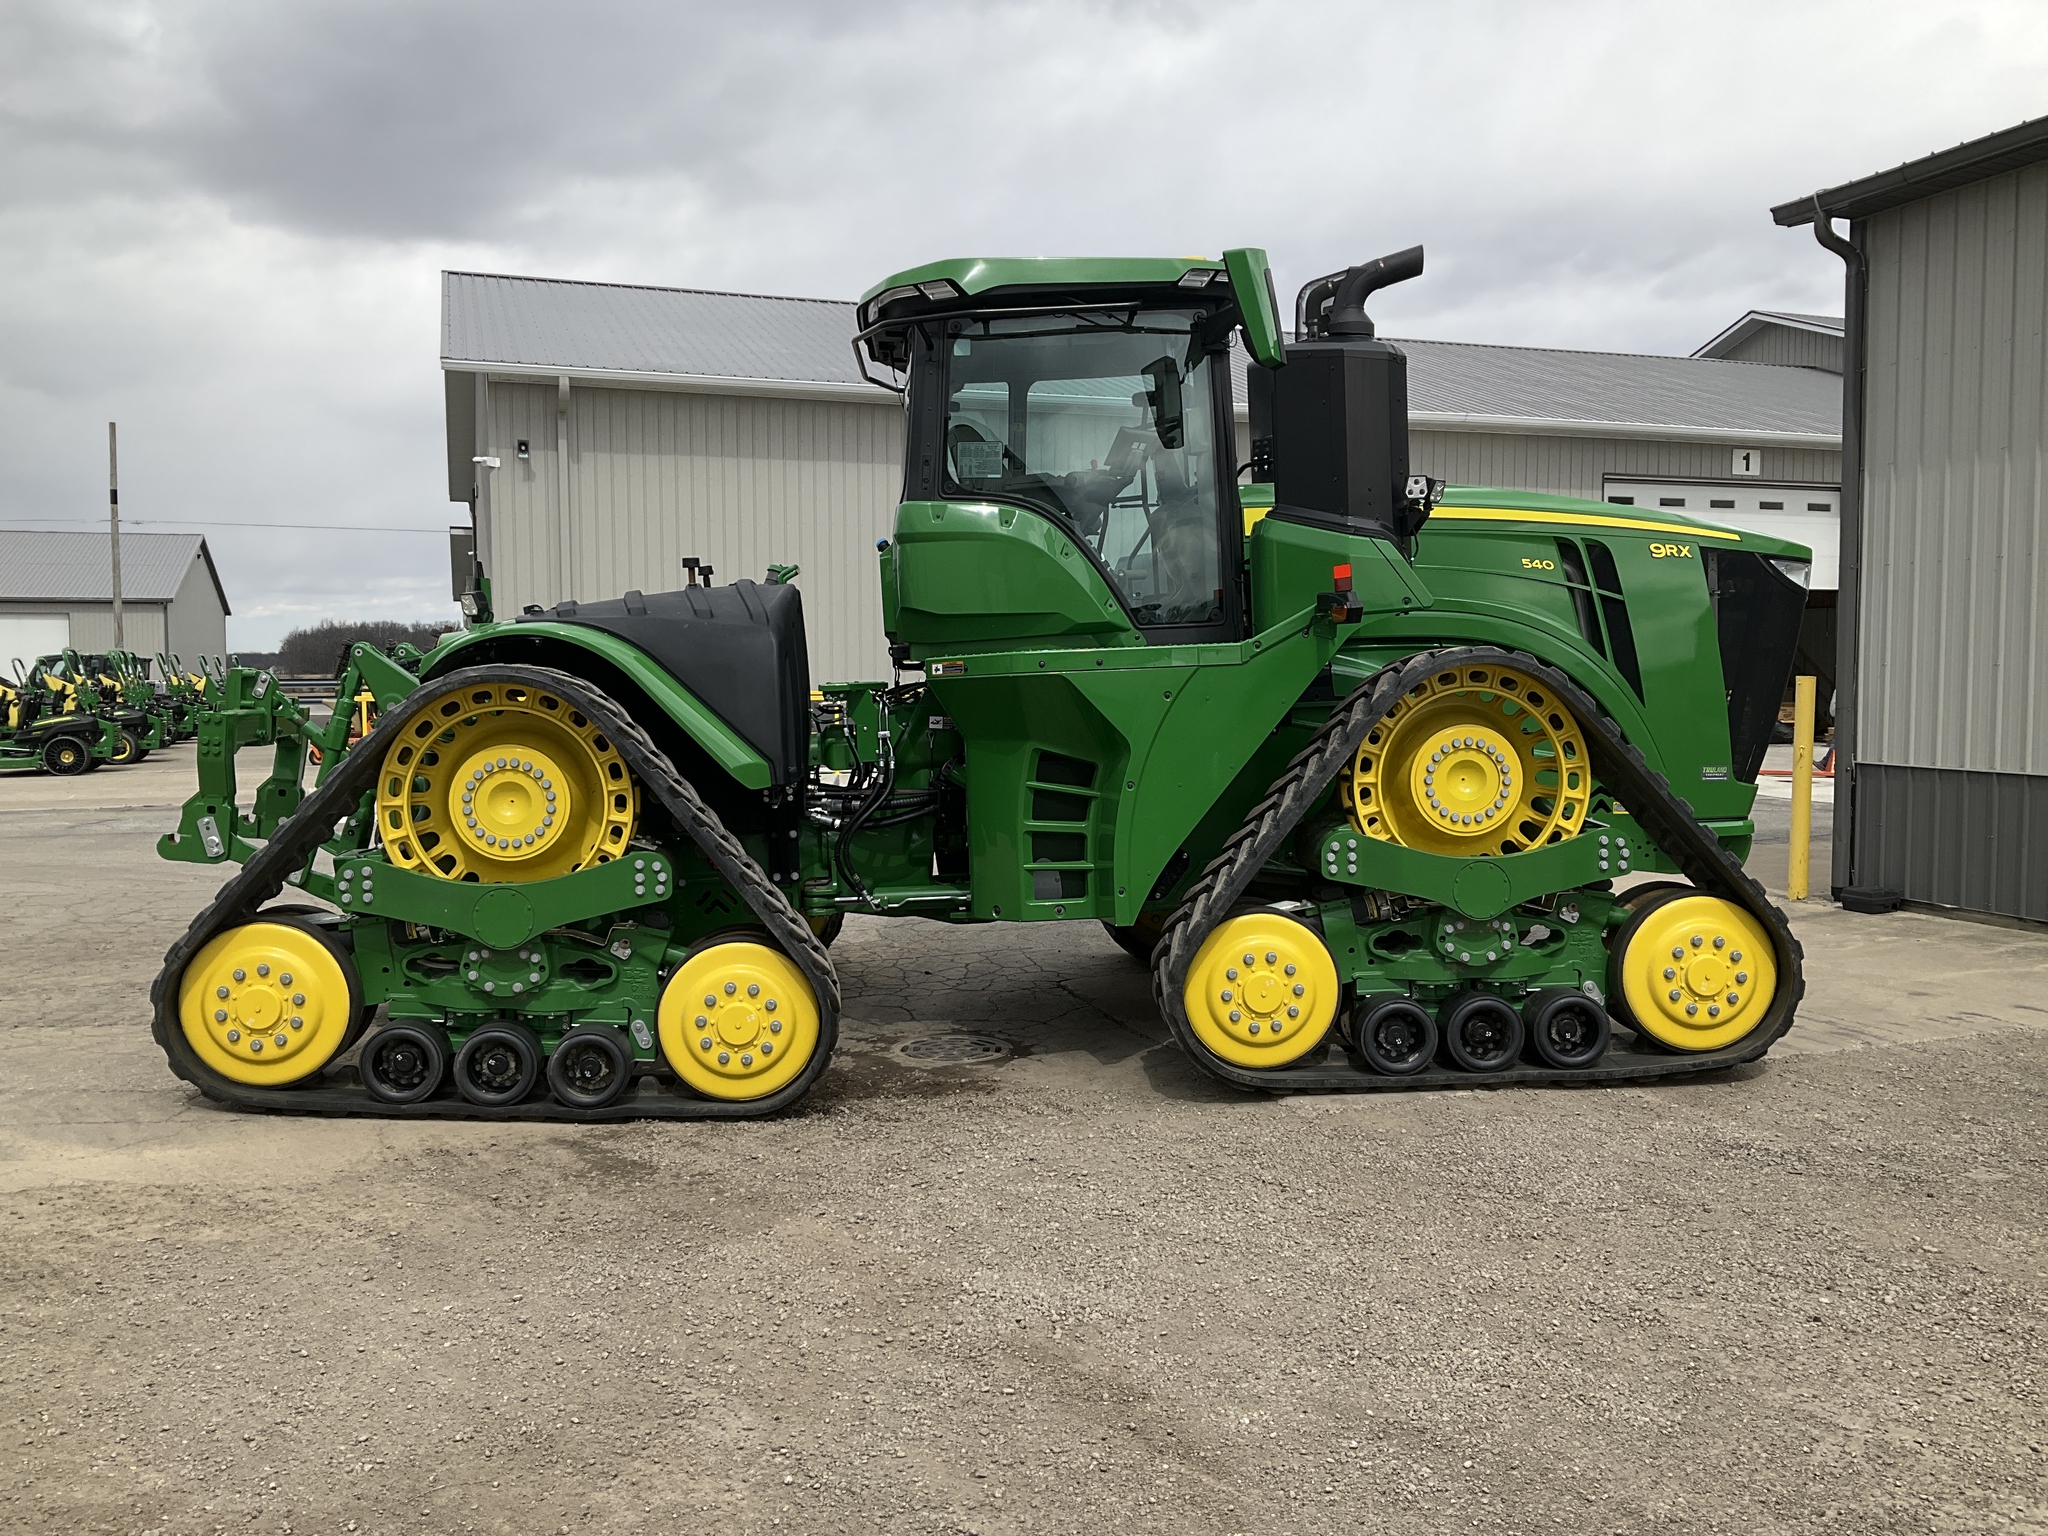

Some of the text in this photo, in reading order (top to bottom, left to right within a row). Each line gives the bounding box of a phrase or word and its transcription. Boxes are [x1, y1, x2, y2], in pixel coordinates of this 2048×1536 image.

[1742, 452, 1750, 472] 1
[1648, 542, 1693, 559] 9RX
[1521, 558, 1555, 571] 540
